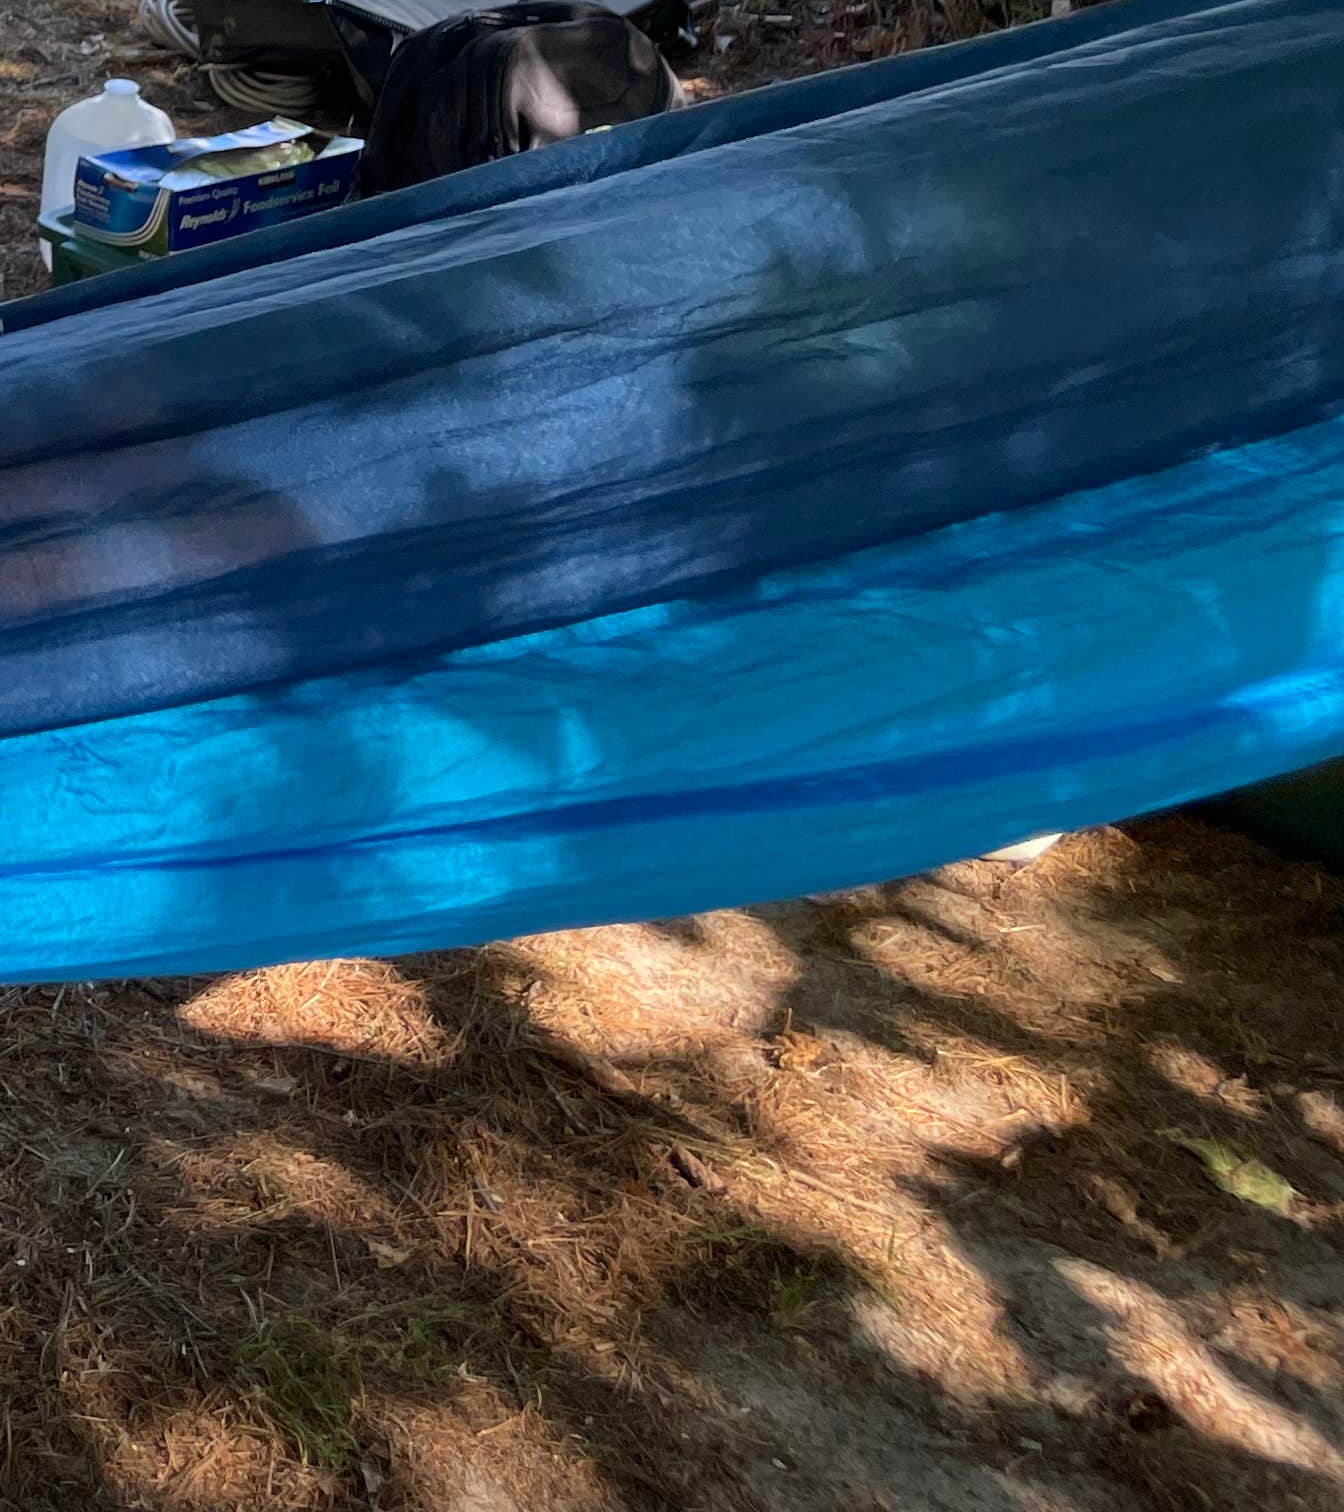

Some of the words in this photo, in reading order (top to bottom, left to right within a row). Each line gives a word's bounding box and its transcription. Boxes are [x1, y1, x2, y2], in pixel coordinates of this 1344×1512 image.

[178, 193, 210, 206] Premium
[180, 207, 227, 230] Reynolds
[243, 189, 314, 215] Foodservice
[318, 180, 340, 197] Foil
